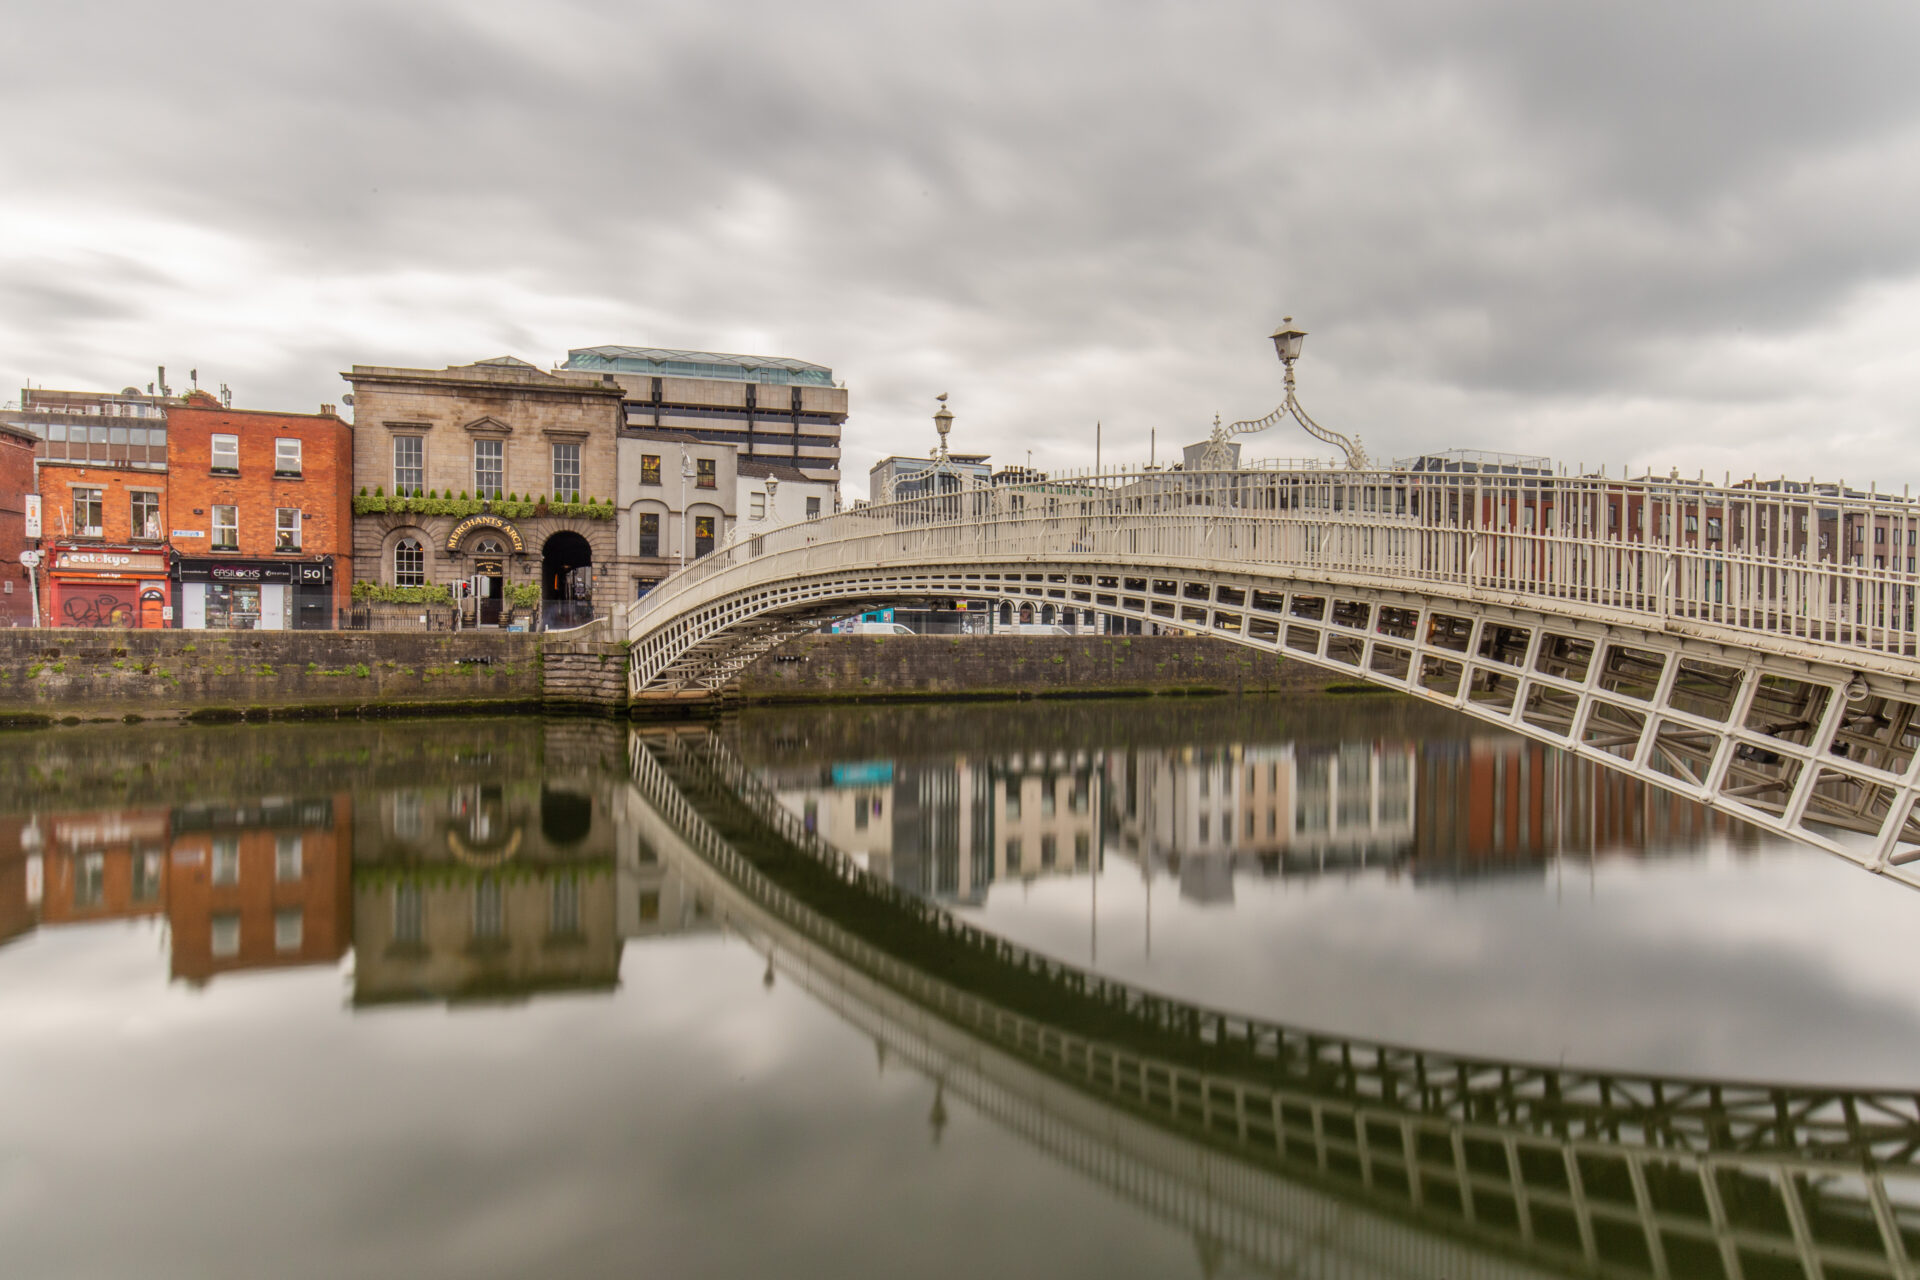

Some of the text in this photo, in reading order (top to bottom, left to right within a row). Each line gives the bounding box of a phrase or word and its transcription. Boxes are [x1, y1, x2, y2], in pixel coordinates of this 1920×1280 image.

[447, 516, 523, 551] MERCHANTS ARCH
[70, 553, 130, 567] eatokyo
[303, 569, 321, 579] 50
